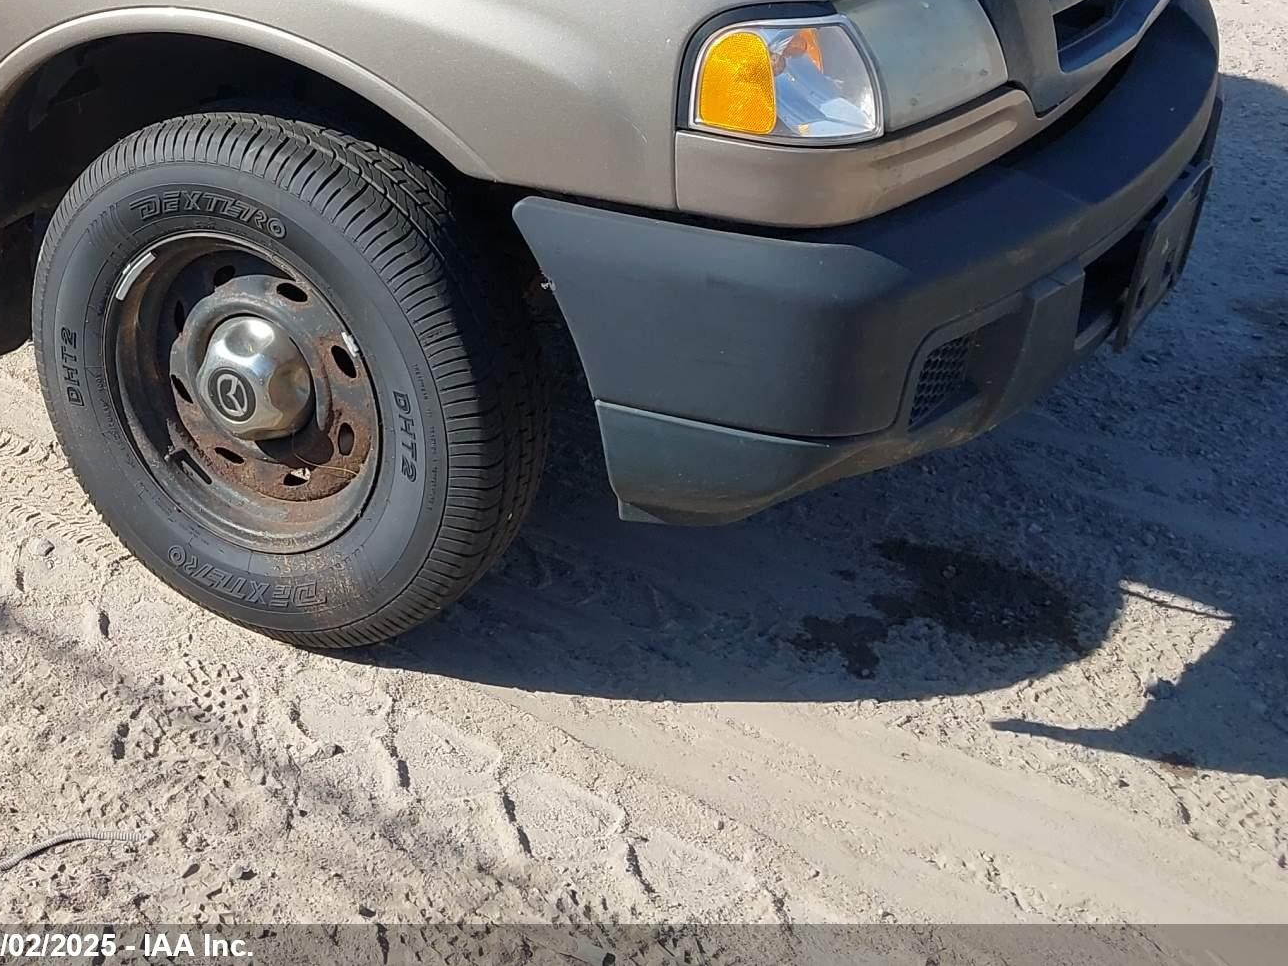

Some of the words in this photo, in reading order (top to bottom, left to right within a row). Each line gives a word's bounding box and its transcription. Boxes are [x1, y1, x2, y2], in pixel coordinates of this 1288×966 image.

[129, 190, 288, 239] DEXTERO
[60, 326, 85, 407] DHT2
[392, 390, 418, 483] DHT2
[168, 545, 328, 609] DEXTERO
